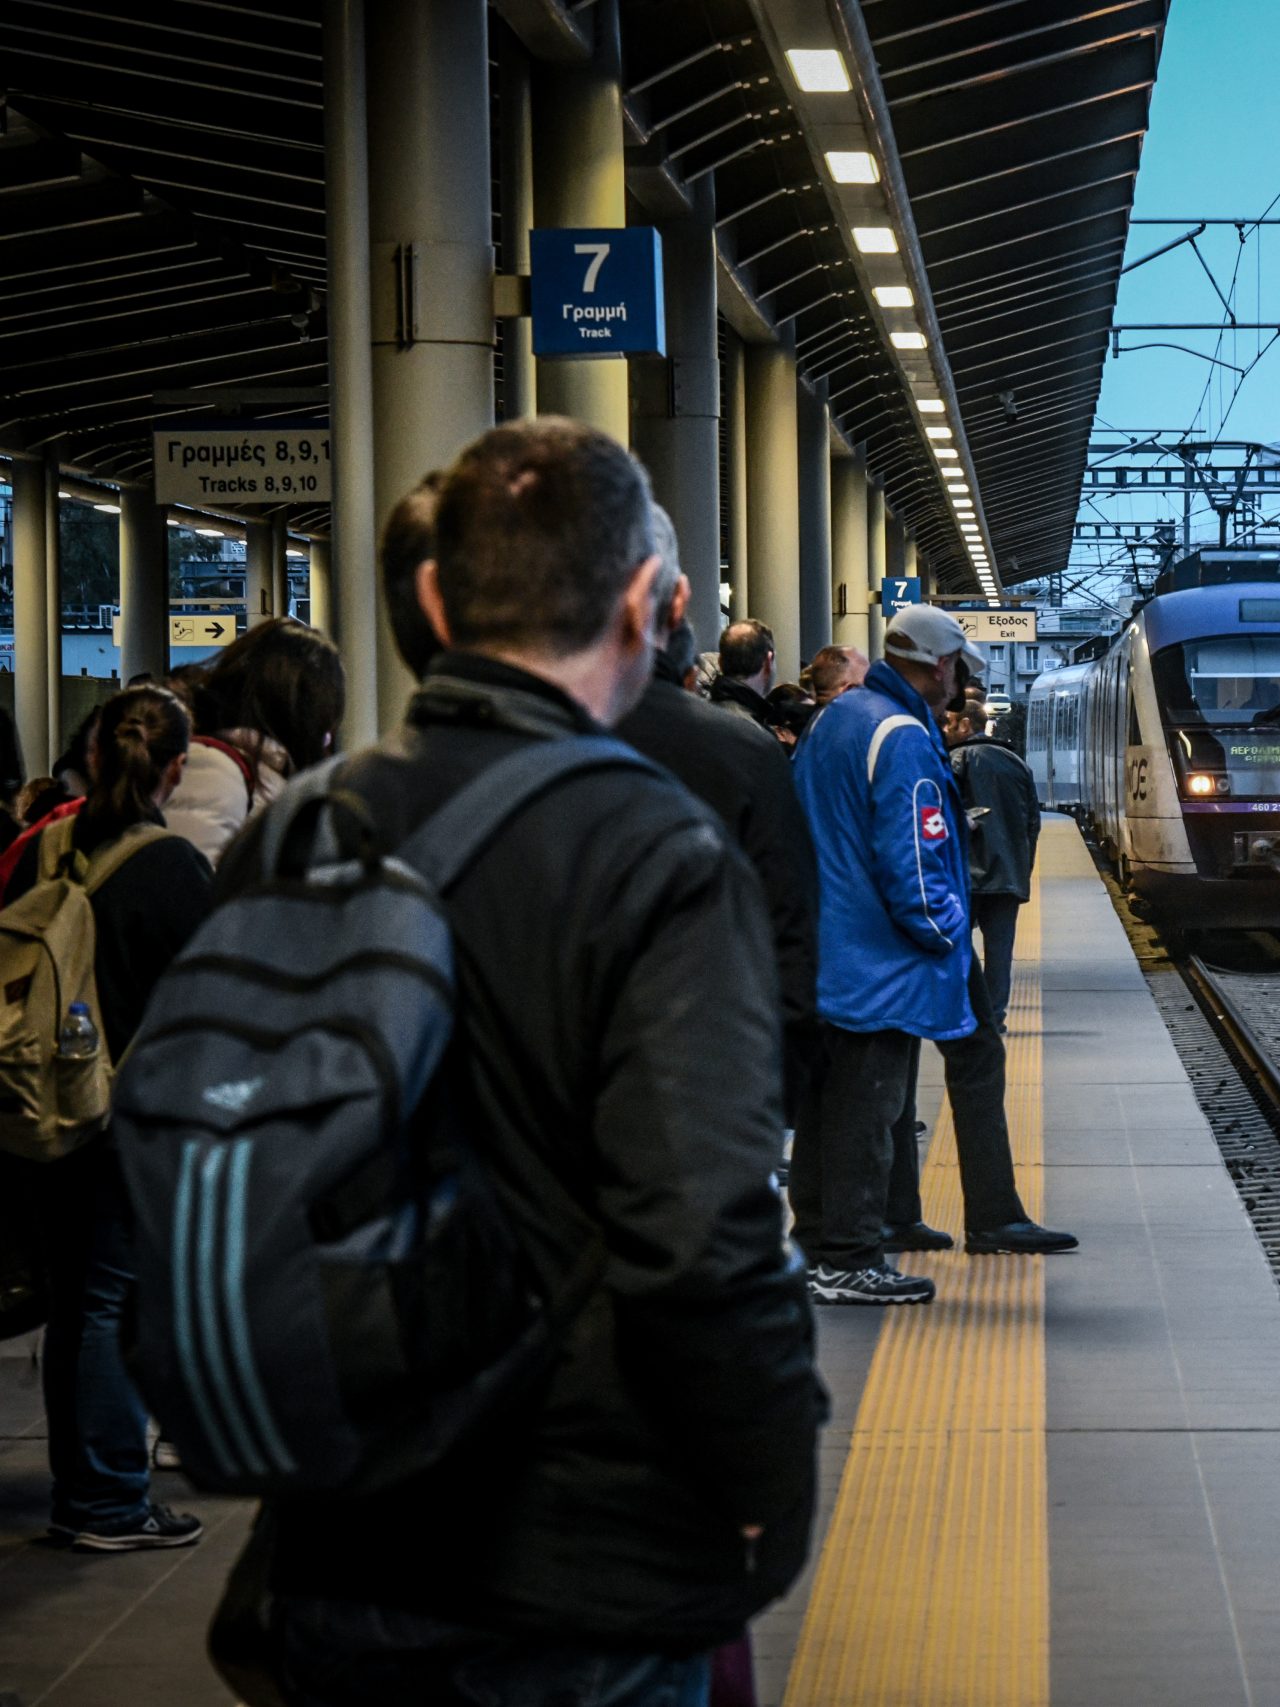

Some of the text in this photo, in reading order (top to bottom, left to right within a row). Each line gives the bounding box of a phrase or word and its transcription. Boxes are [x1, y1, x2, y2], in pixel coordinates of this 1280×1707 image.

[574, 243, 610, 293] 7
[562, 302, 627, 322] Γραμμή
[579, 327, 612, 338] Track
[167, 439, 330, 468] Γραμμές 8,9,1
[198, 475, 318, 494] Tracks 8,9,10
[894, 581, 908, 599] 7
[986, 615, 1028, 627] Έξοδος
[1000, 630, 1016, 638] Exit
[1252, 803, 1270, 812] 460
